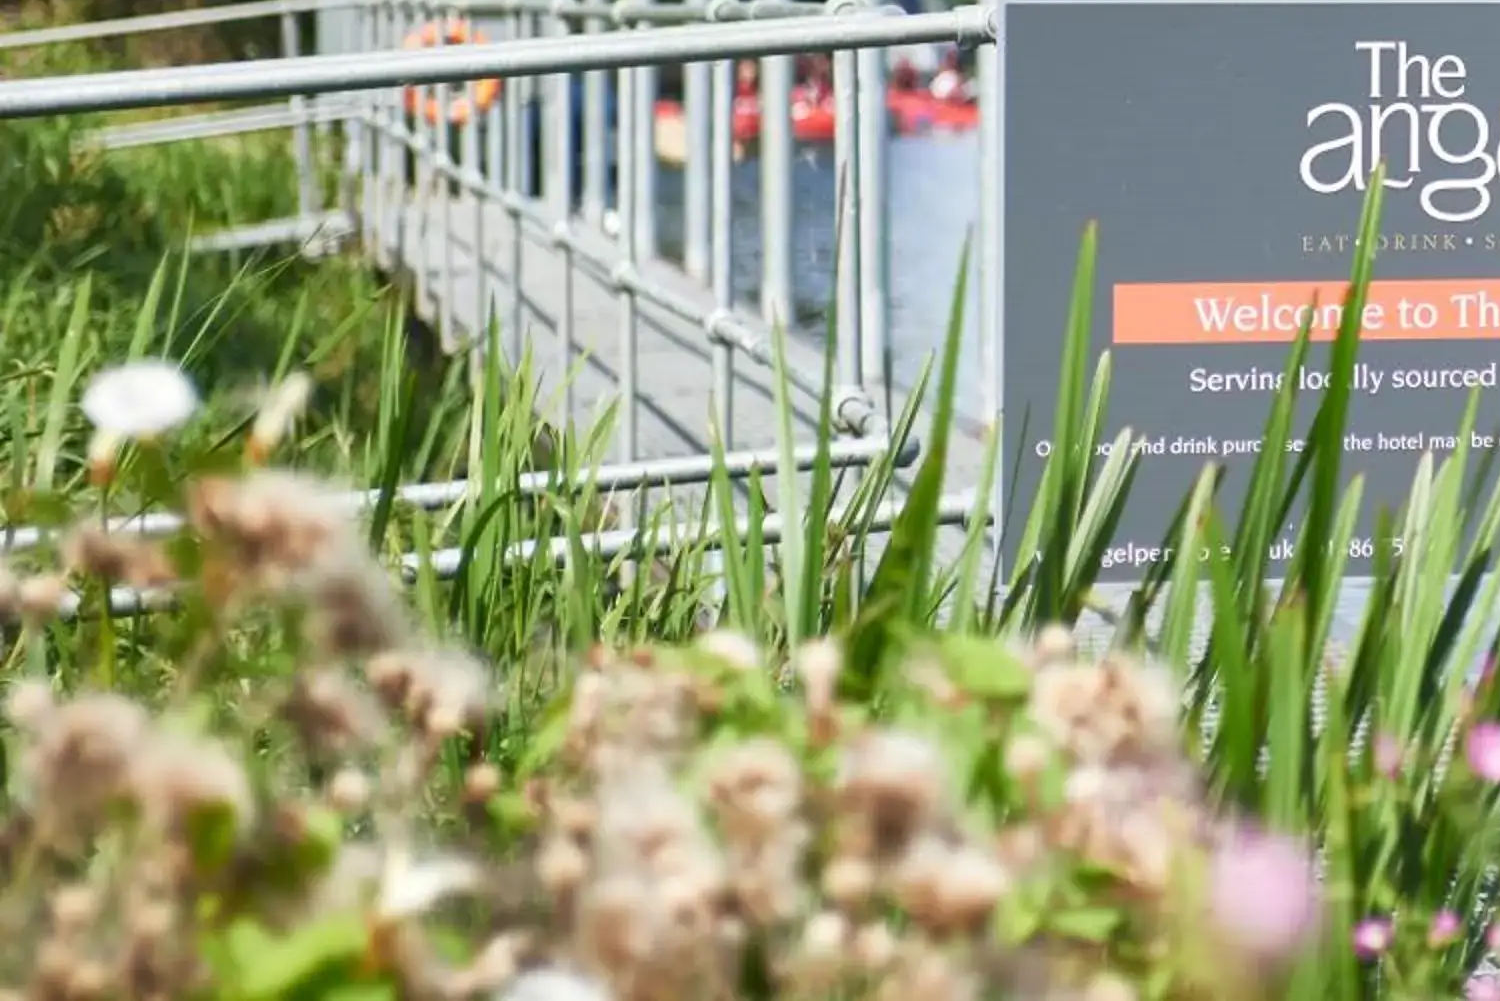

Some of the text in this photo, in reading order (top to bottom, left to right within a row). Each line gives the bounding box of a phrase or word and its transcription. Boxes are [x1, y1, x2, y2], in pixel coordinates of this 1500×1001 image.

[1355, 41, 1466, 98] The
[1302, 234, 1350, 252] EAT
[1375, 233, 1456, 251] DRINK
[1398, 298, 1438, 329] to
[1299, 363, 1384, 394] loclly
[1391, 363, 1497, 388] sourced
[1170, 435, 1217, 455] drink
[1344, 432, 1372, 452] the
[1378, 431, 1424, 451] hotel
[1471, 430, 1495, 448] be
